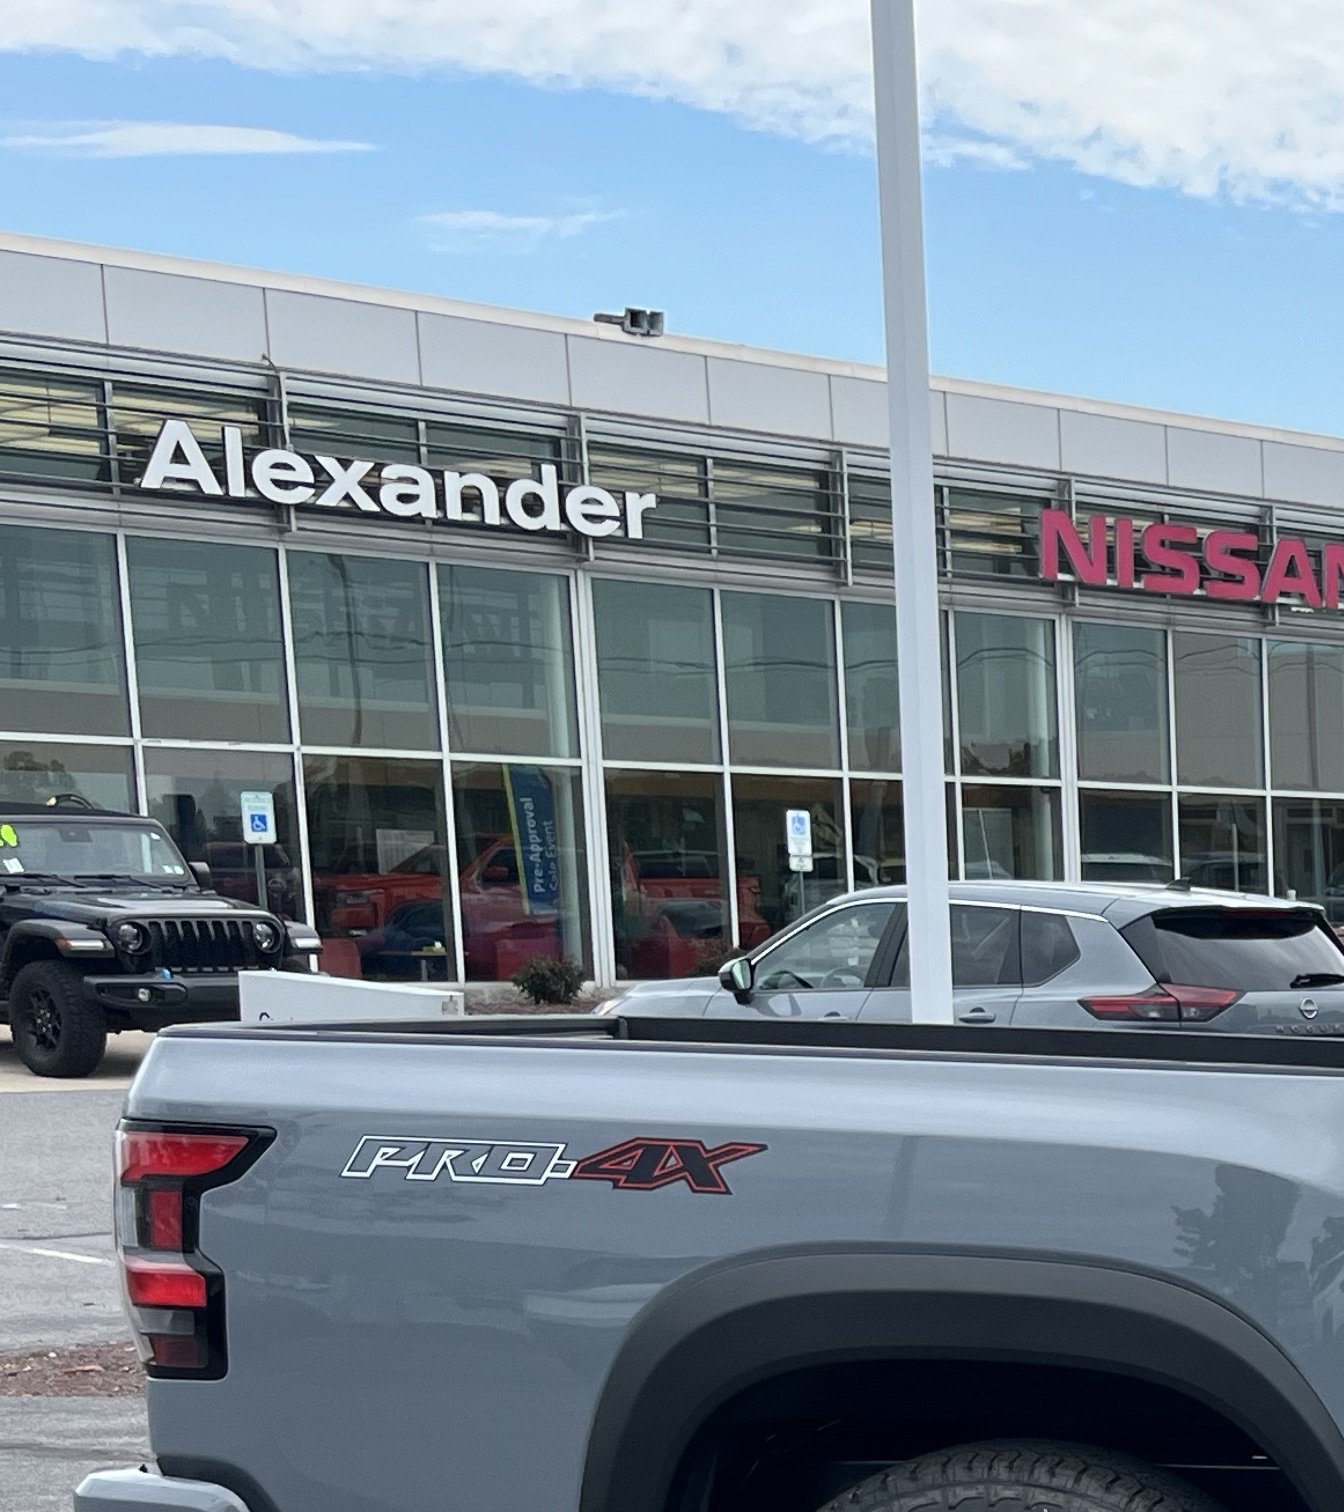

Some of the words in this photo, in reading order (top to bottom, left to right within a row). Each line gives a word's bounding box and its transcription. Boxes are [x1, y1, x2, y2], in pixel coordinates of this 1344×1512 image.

[140, 419, 656, 539] Alexander
[520, 797, 546, 893] Pre-Approval
[340, 1134, 769, 1196] PRO-4X
